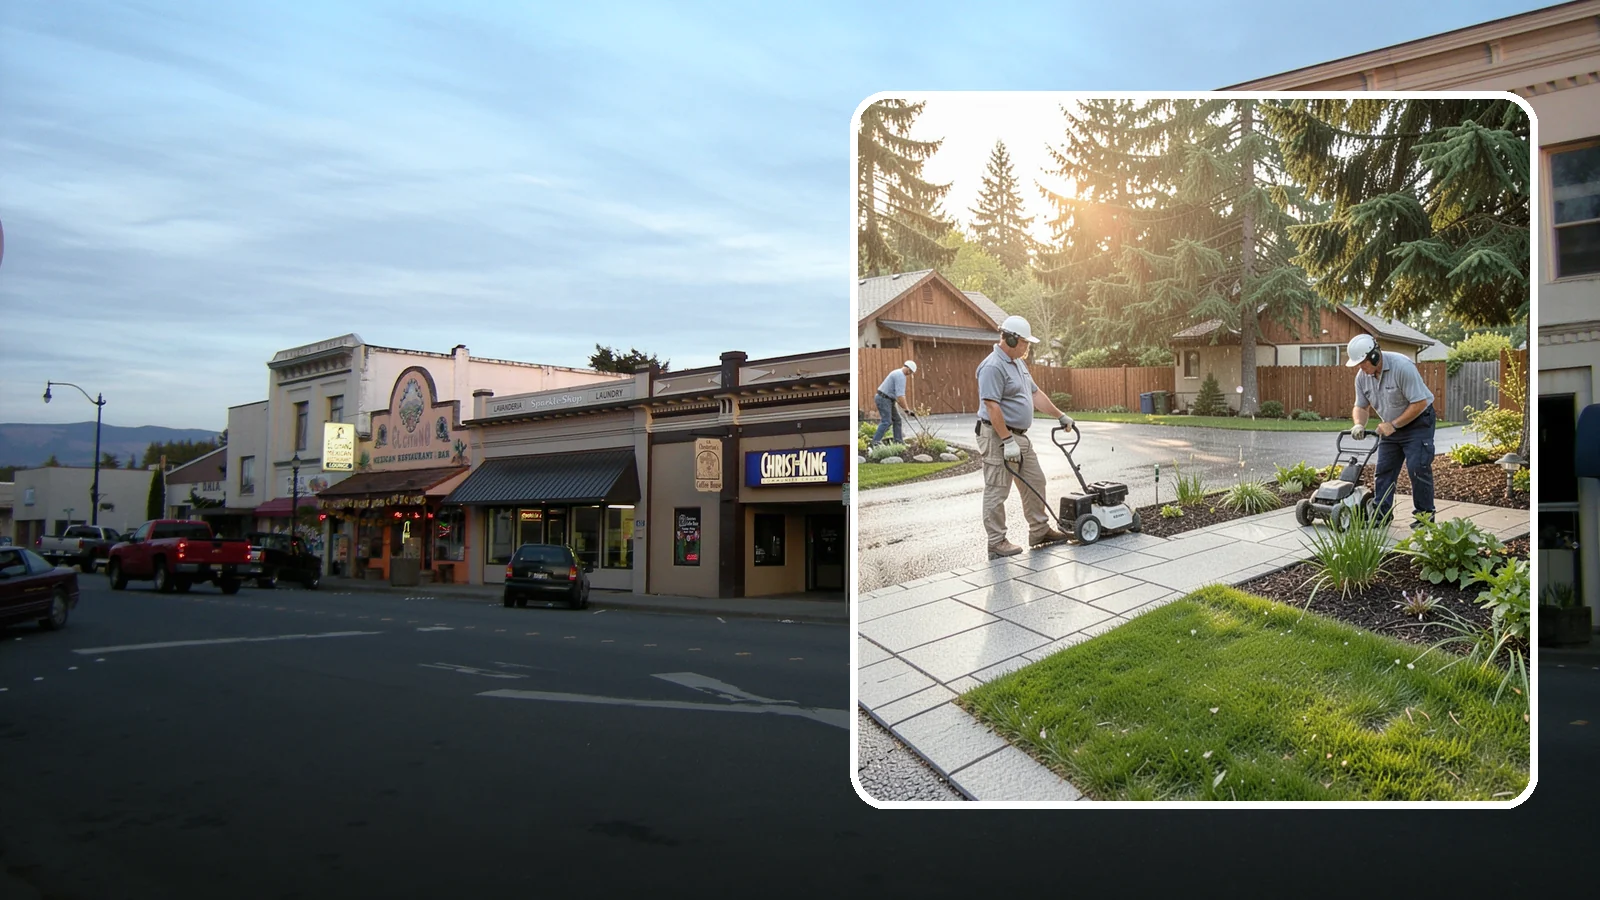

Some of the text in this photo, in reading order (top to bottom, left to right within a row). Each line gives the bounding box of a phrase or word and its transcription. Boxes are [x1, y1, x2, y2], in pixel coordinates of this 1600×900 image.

[531, 394, 582, 409] Sparkle Shop
[596, 389, 623, 400] LAUNDRY
[494, 402, 522, 412] LAVANDERIA
[373, 455, 396, 464] MEXICAN
[397, 451, 433, 462] RESTAURANT
[437, 449, 450, 459] BAR
[761, 450, 827, 478] CHRIST KING
